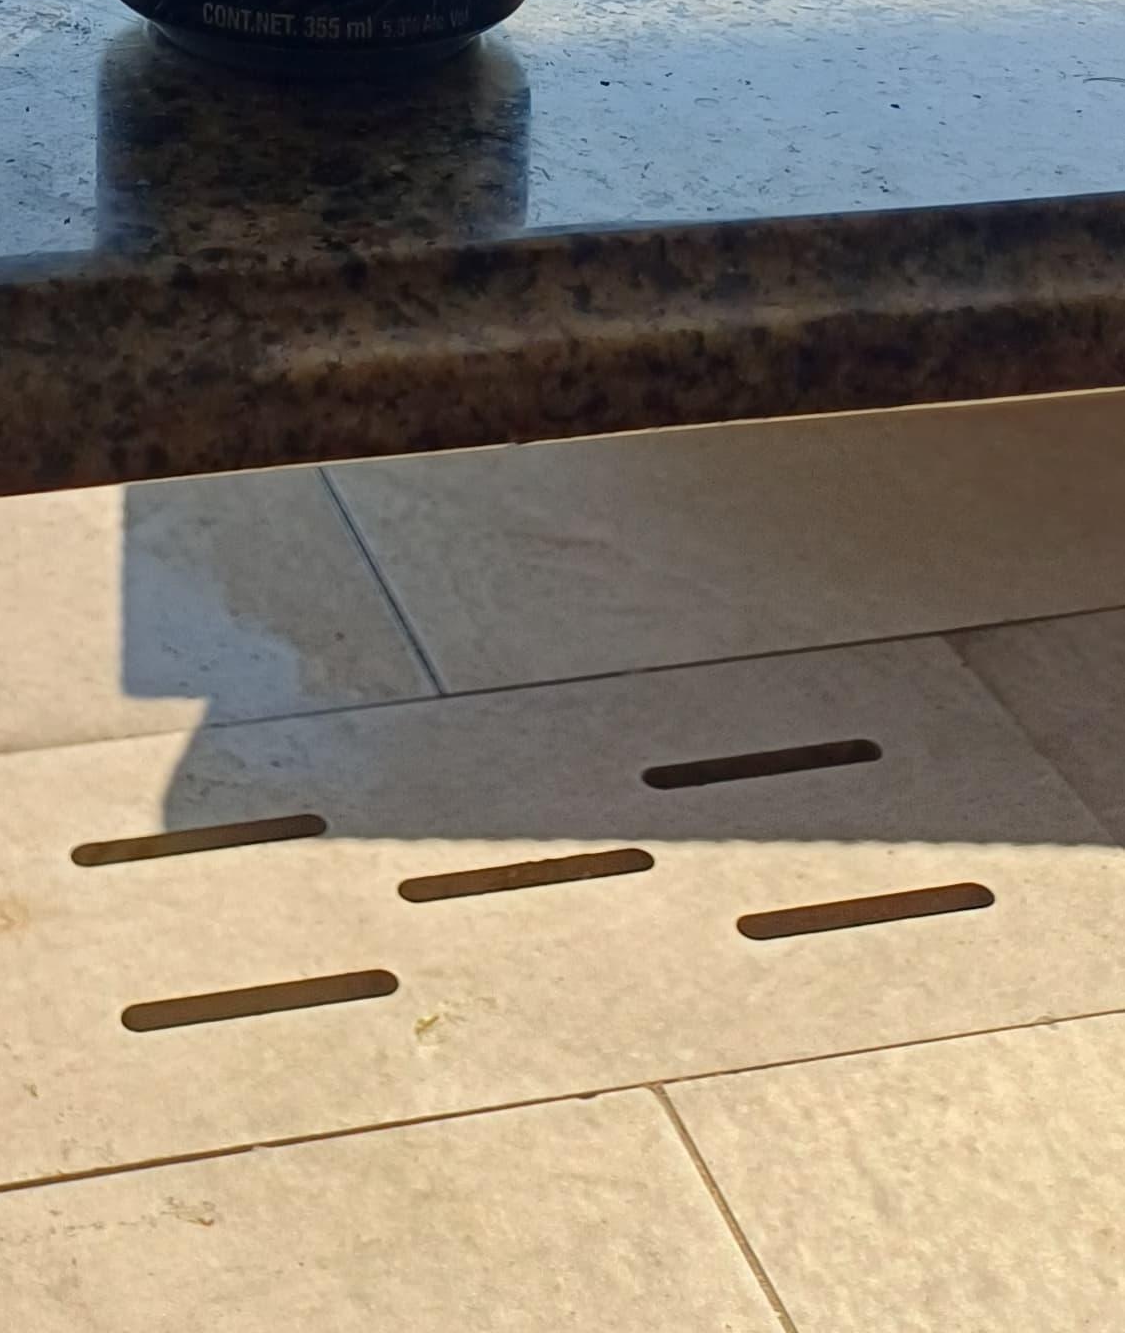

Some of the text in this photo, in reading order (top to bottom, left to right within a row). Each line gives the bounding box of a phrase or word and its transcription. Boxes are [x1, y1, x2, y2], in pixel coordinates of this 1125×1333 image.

[202, 1, 298, 36] CONT.NET.
[303, 15, 341, 39] 355
[346, 15, 373, 39] ml
